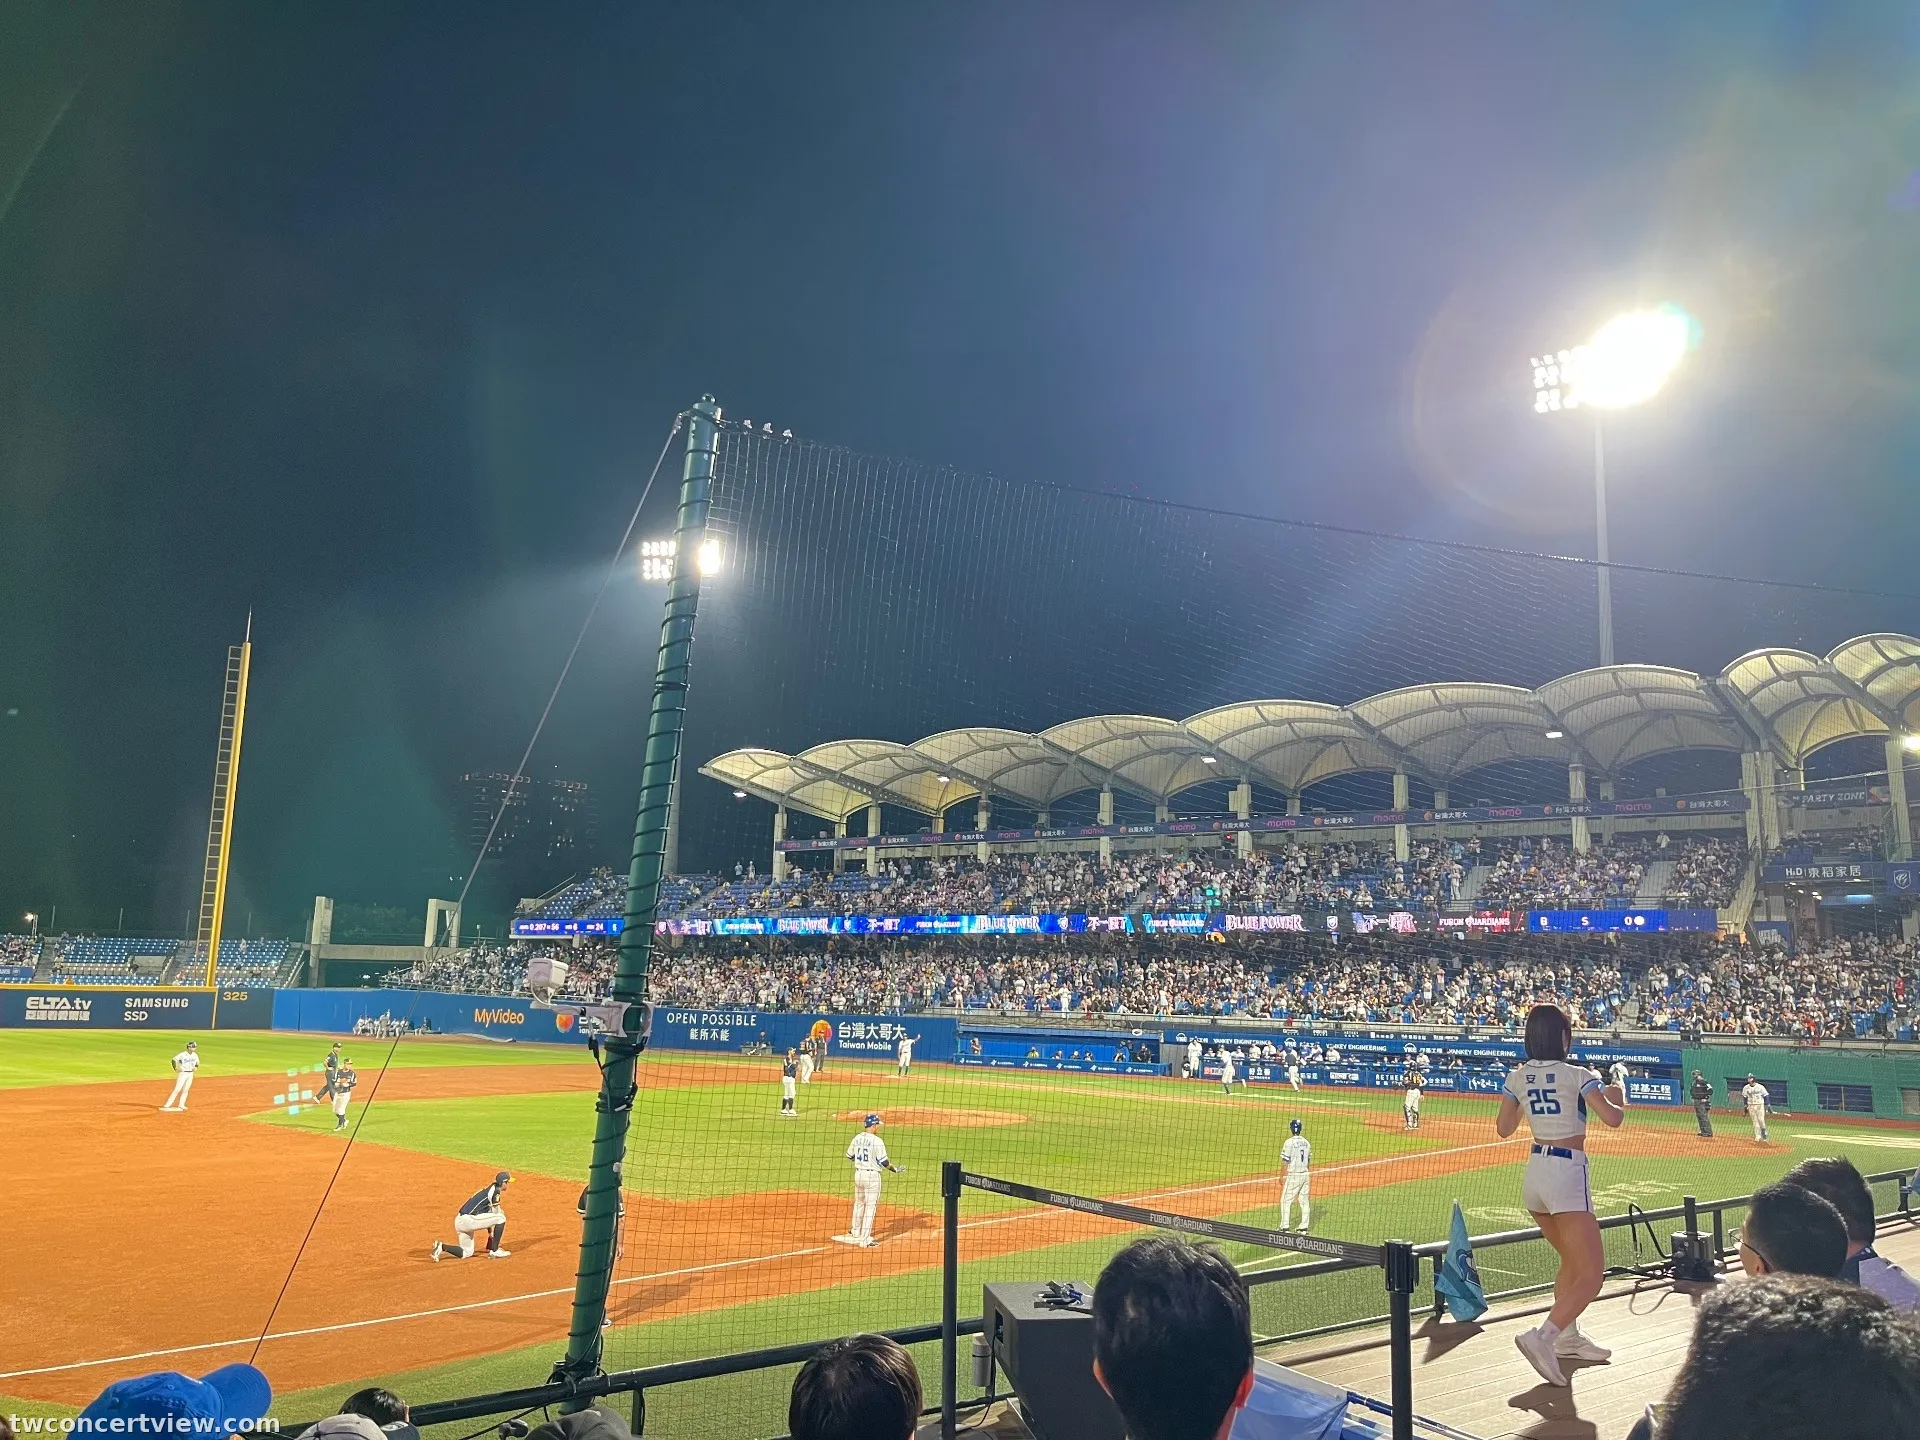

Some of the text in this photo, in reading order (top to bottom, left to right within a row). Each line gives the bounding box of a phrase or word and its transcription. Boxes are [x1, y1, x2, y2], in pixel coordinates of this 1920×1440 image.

[1802, 794, 1835, 803] PARTY
[1838, 792, 1865, 801] ZONE
[1555, 804, 1592, 814] 台灣大哥大
[1615, 803, 1651, 812] momo
[1690, 800, 1730, 809] 台灣大哥大
[1434, 811, 1468, 819] 台灣大哥大
[1488, 808, 1522, 817] momo
[1267, 819, 1296, 828] momo
[1324, 817, 1354, 825] 台灣大哥大
[1169, 823, 1196, 831] momo
[920, 835, 943, 843] momo
[1006, 915, 1040, 931] POWER
[1226, 914, 1304, 931] BLUE POWER
[1581, 916, 1589, 926] S
[223, 991, 248, 1001] 325
[26, 996, 92, 1010] ELTA.tv
[124, 997, 189, 1008] SAMSUNG
[124, 1010, 149, 1022] SSD
[474, 1008, 525, 1028] MyVideo
[666, 1012, 757, 1026] OPEN POSSIBLE
[689, 1028, 730, 1042] 能所不能
[838, 1021, 906, 1040] 台灣大哥大
[839, 1039, 892, 1051] Taiwan Mobile
[1348, 1044, 1387, 1052] ENGINEERING
[1447, 1048, 1516, 1057] YANKEY ENGINEERING
[1612, 1054, 1660, 1063] ENGINEERING
[1630, 1083, 1672, 1094] 洋基工程
[1527, 1088, 1561, 1115] 25
[1050, 1193, 1069, 1205] FUBON
[1150, 1213, 1213, 1233] FUBON GUARDIANS
[1268, 1233, 1344, 1255] FUBON GUARDIANS
